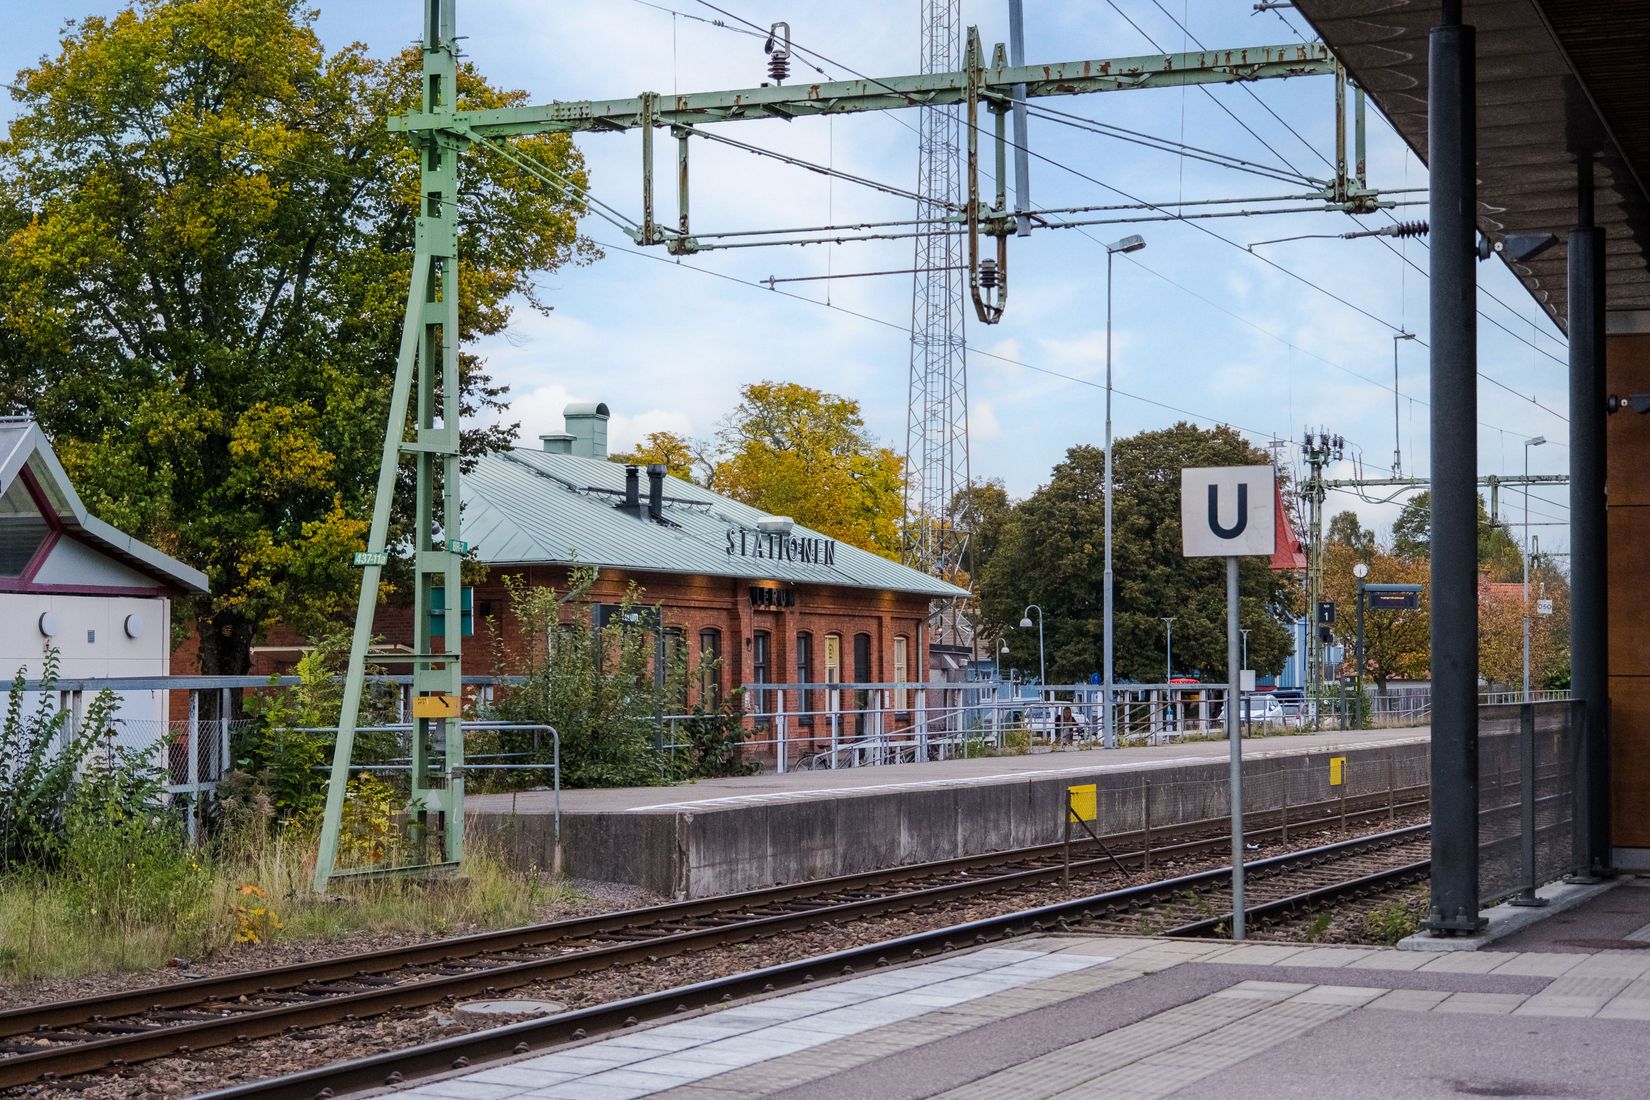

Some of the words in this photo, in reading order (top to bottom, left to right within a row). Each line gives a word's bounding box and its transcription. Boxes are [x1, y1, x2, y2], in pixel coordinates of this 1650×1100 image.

[1208, 483, 1248, 539] U
[726, 528, 835, 564] STATIONEN
[356, 553, 385, 564] 437-11a
[1324, 612, 1329, 621] 1
